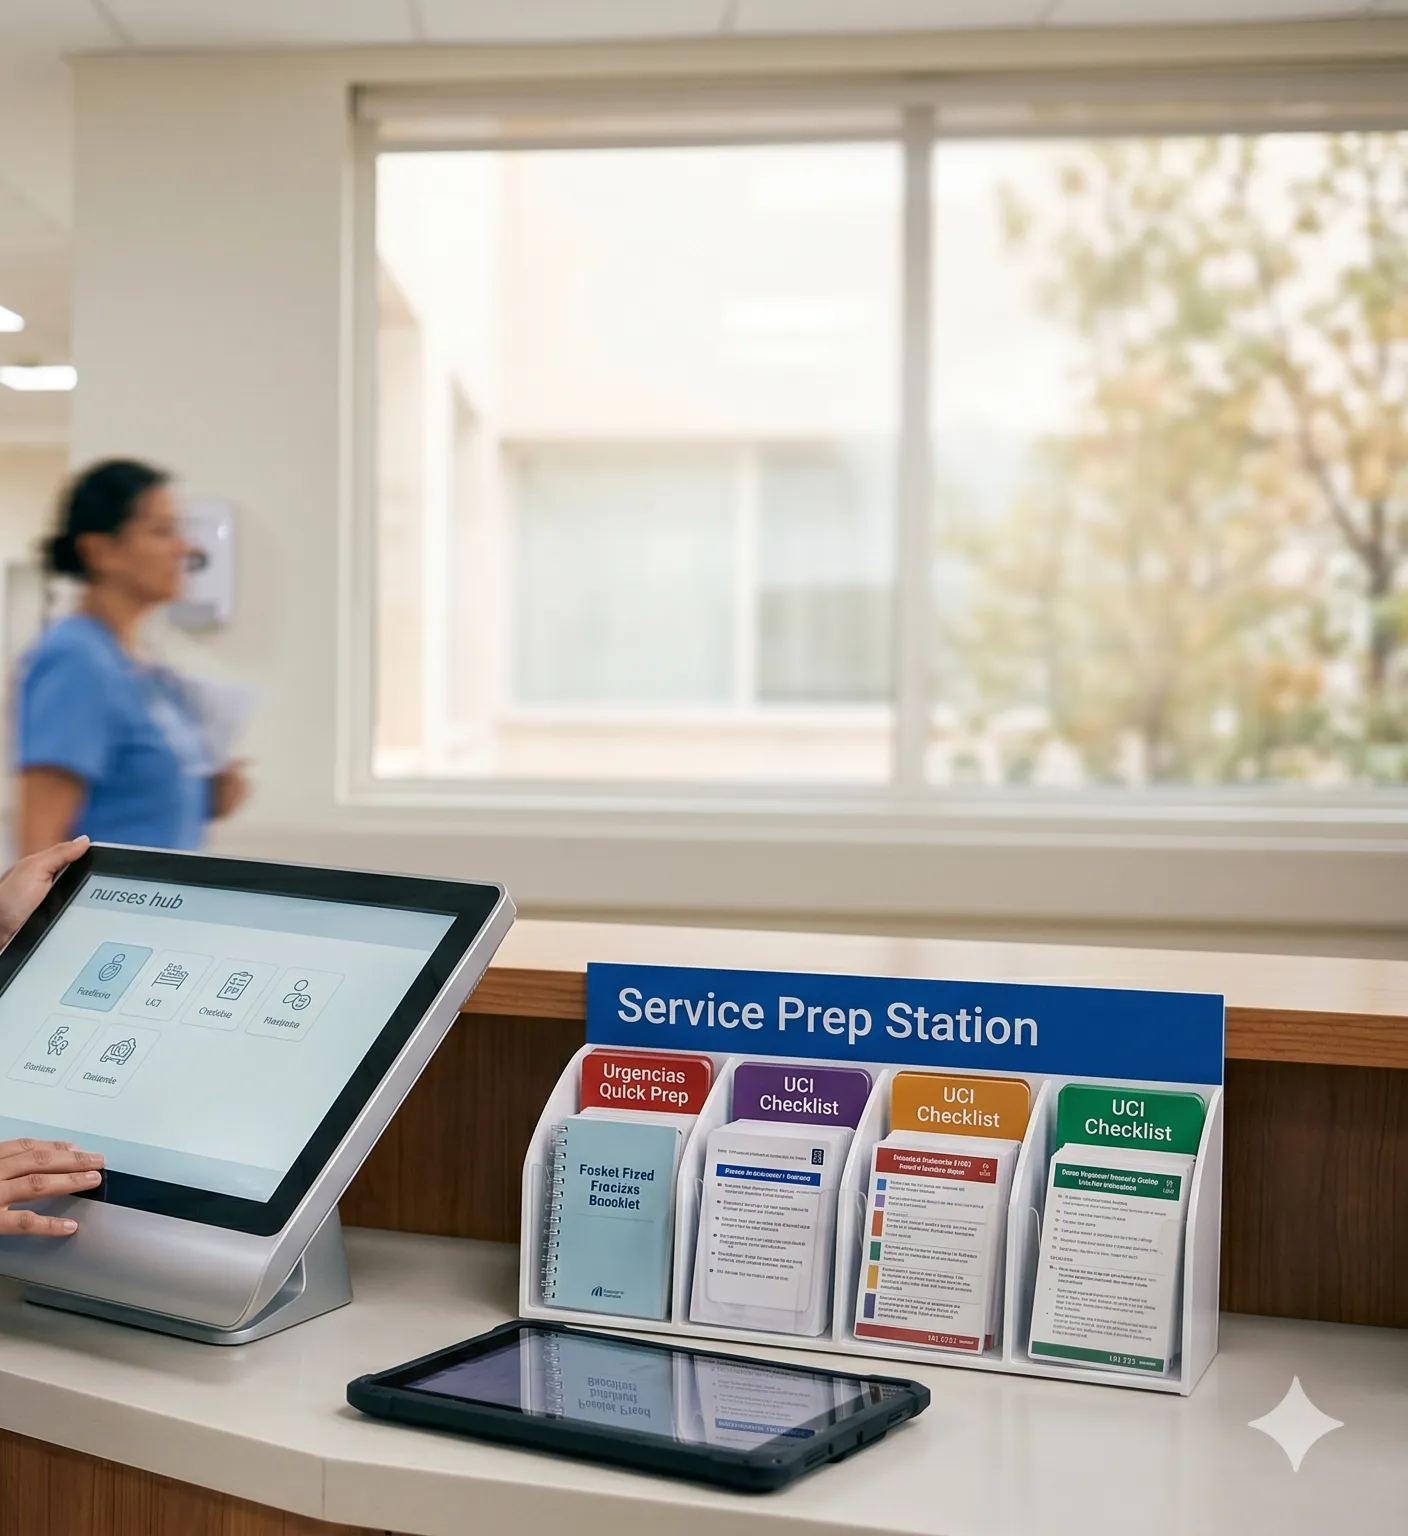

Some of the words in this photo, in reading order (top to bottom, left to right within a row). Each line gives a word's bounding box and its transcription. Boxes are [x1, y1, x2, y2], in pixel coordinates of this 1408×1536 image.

[90, 888, 148, 905] nurses
[148, 891, 184, 909] hub
[617, 987, 765, 1030] Service
[778, 996, 873, 1045] Prep
[886, 1002, 1039, 1046] Station
[603, 1063, 686, 1084] Urgencias
[784, 1076, 814, 1094] UCI
[943, 1086, 975, 1104] UCI
[651, 1086, 689, 1107] Prep
[760, 1095, 839, 1116] Checklist
[917, 1106, 1000, 1128] Checklist
[1112, 1099, 1145, 1117] UCI
[1085, 1118, 1172, 1142] Checklist
